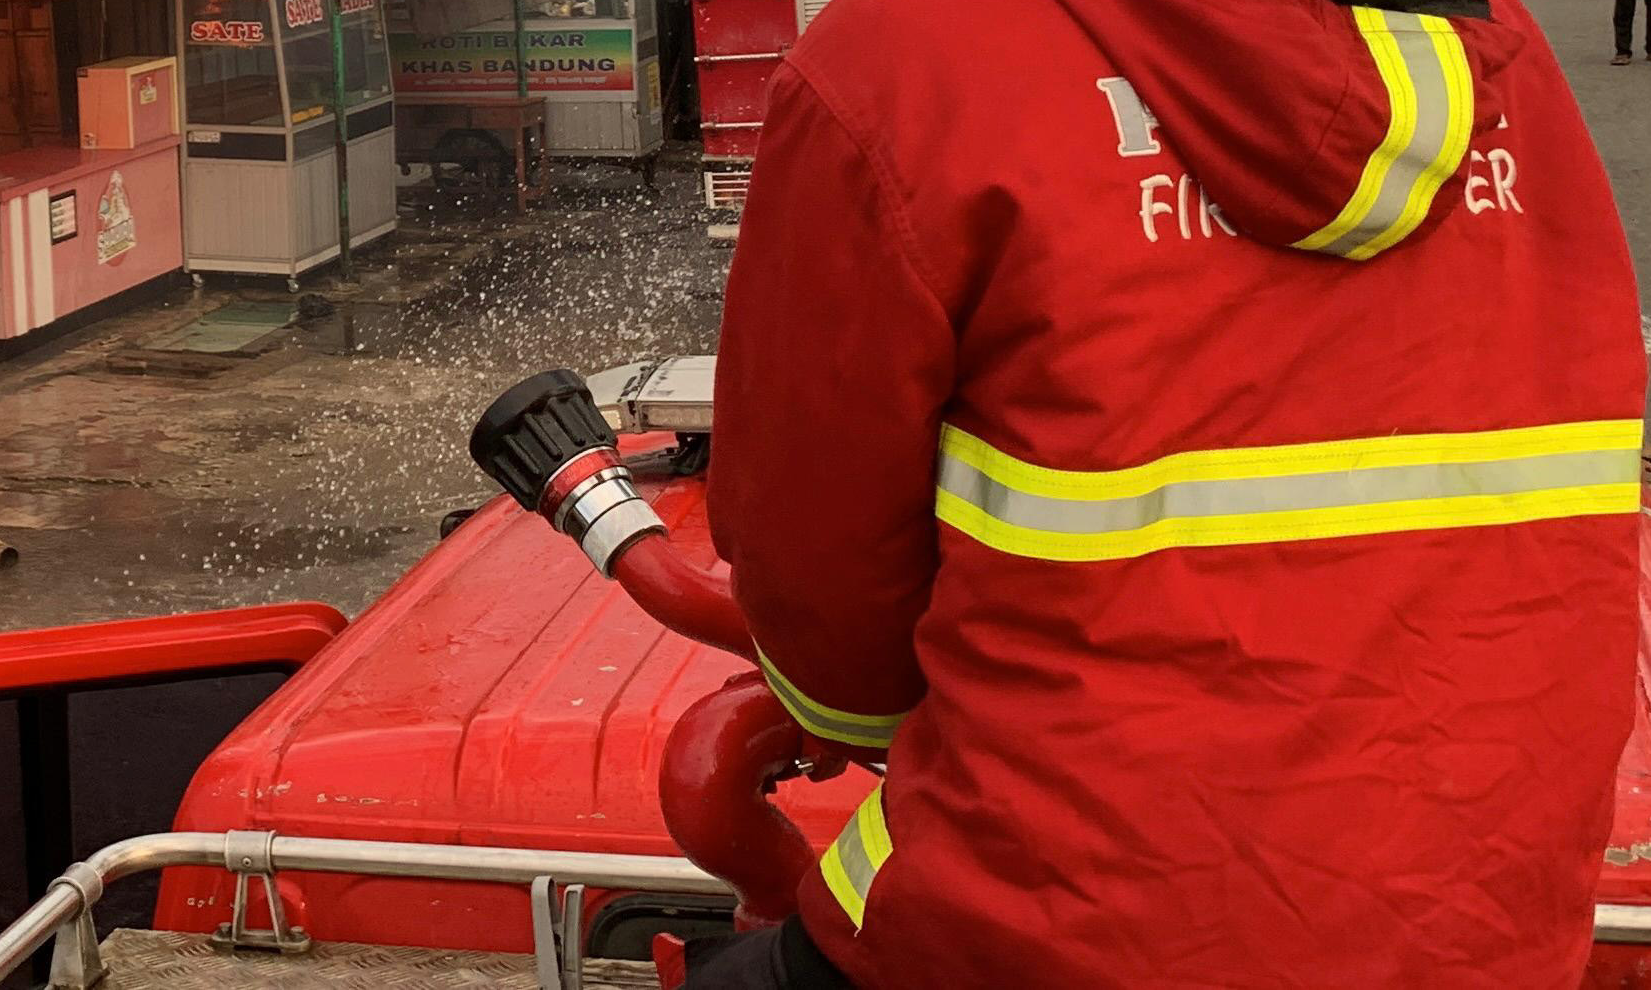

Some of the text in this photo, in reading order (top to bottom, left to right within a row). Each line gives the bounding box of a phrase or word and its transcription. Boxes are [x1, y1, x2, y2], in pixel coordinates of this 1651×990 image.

[191, 21, 264, 42] SATE
[421, 33, 585, 50] ROTI BKAR
[402, 57, 616, 74] KHAS BANDUNG
